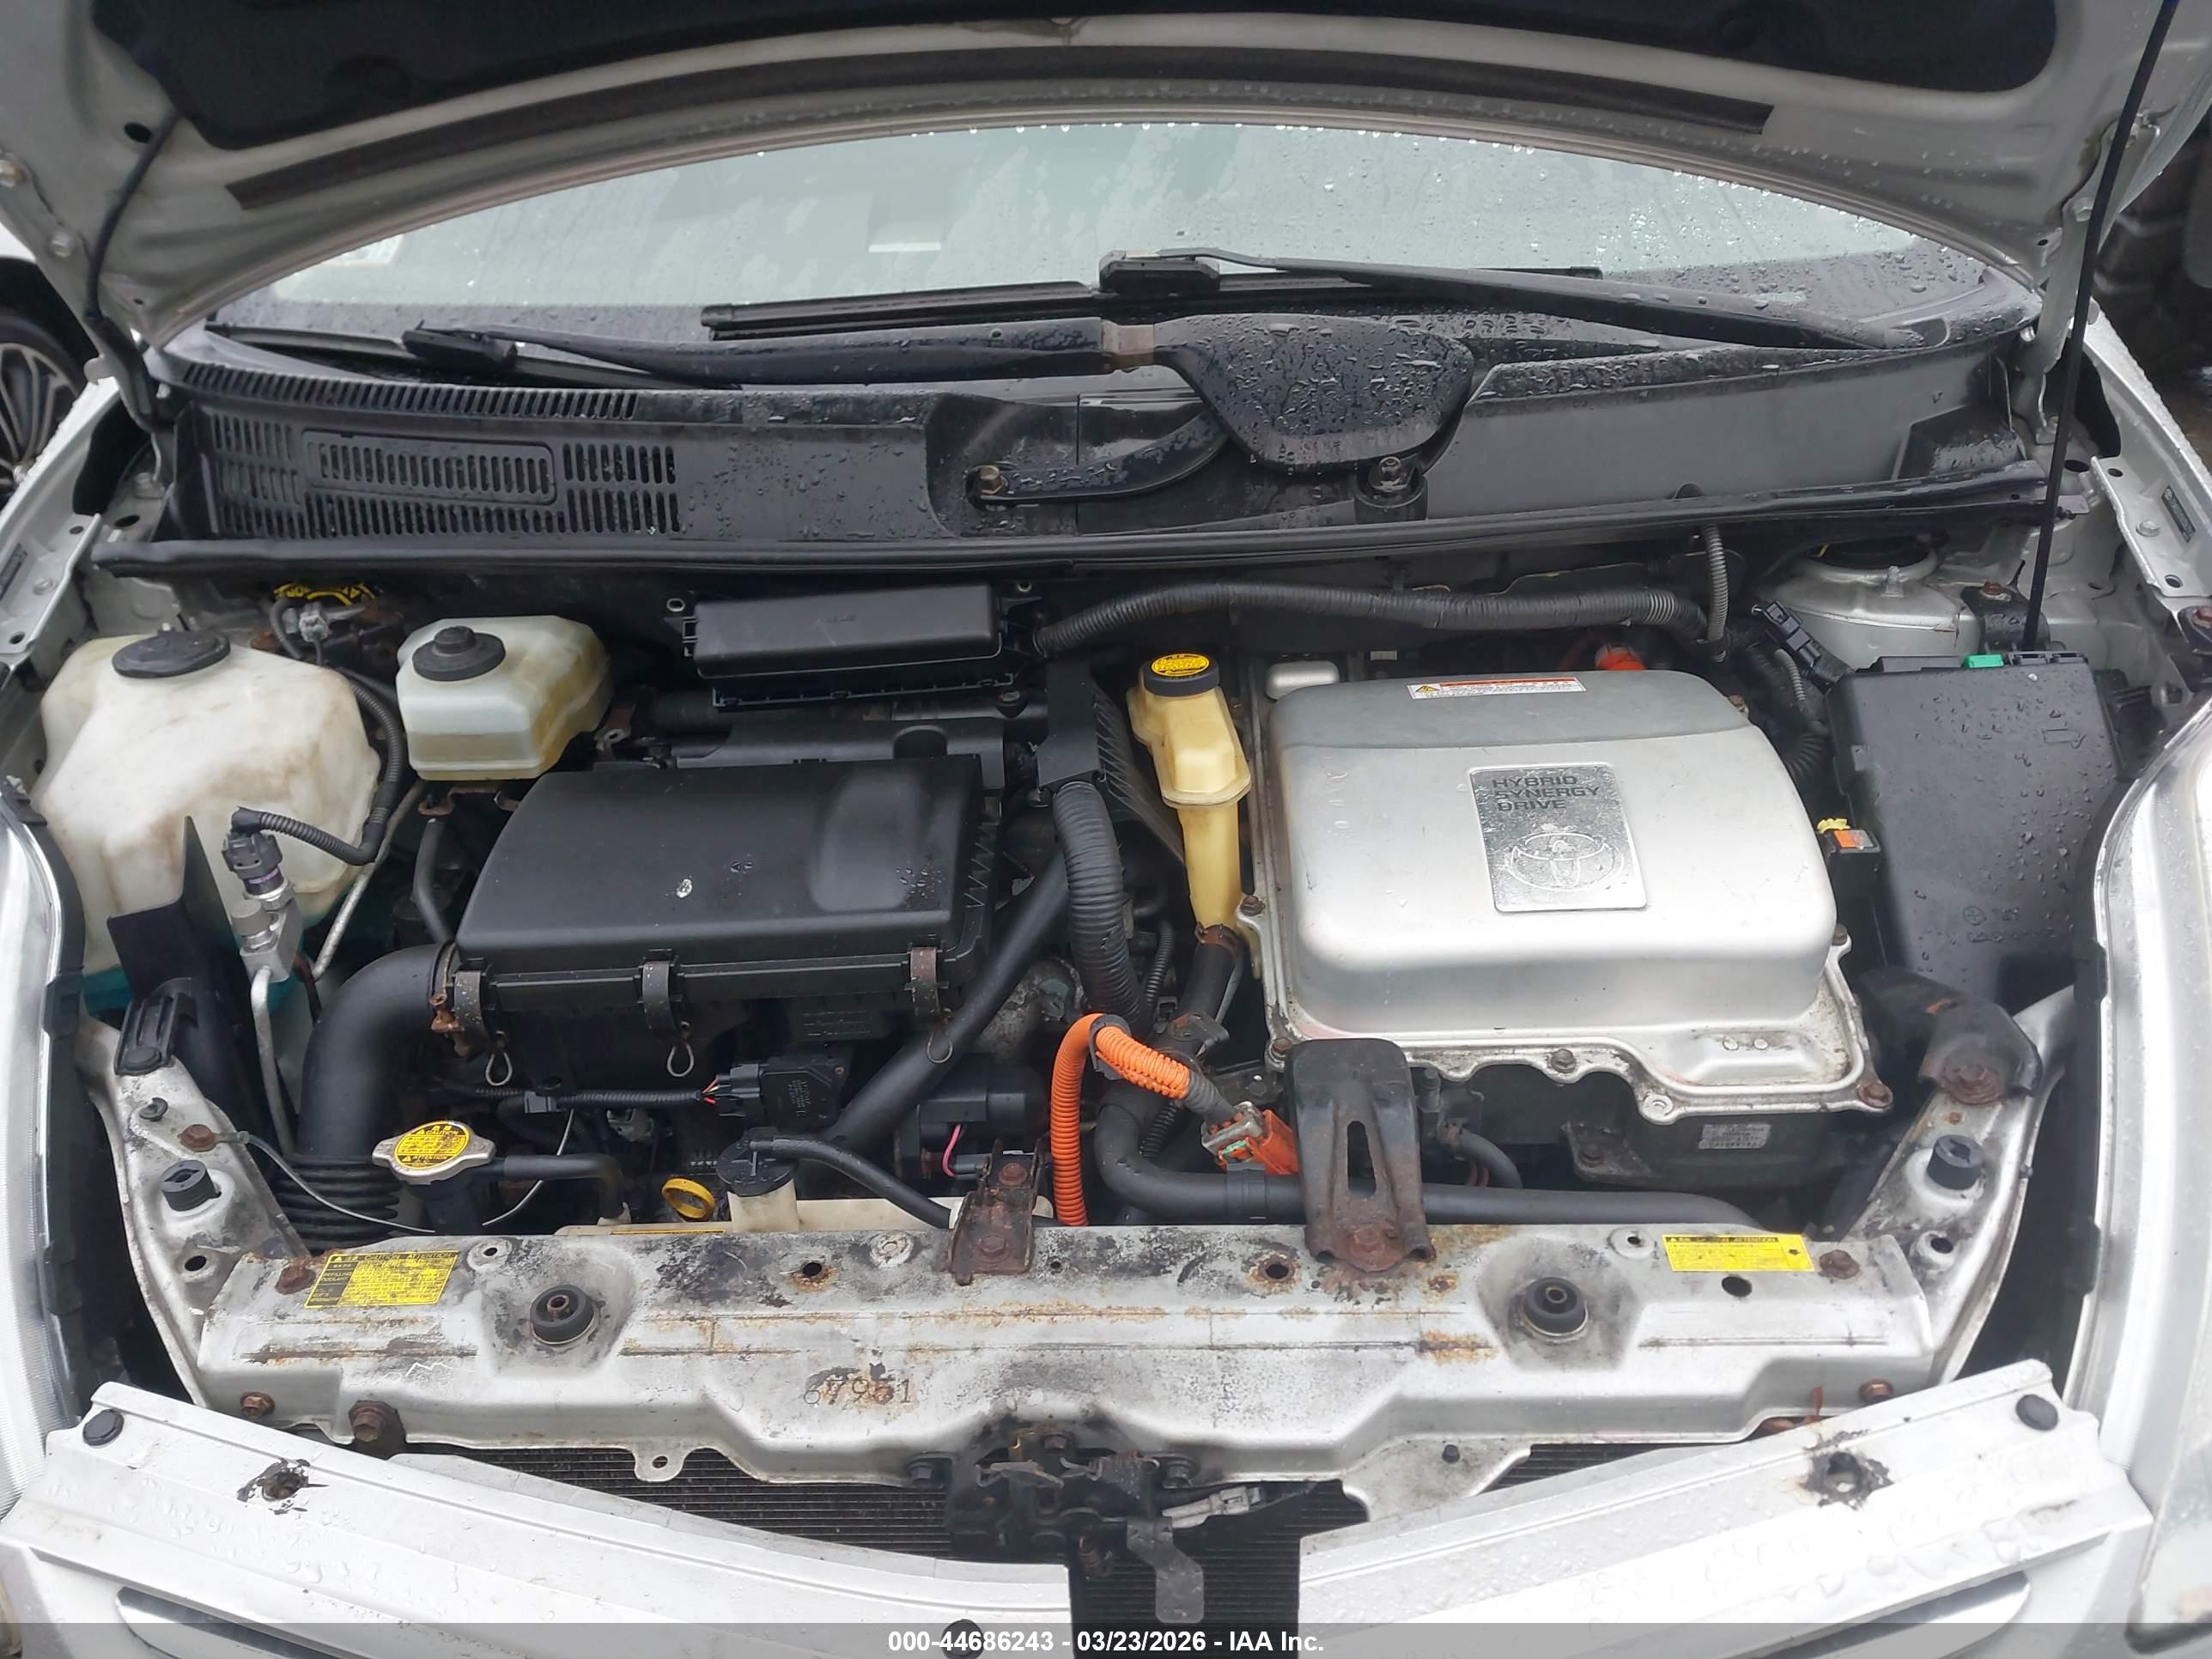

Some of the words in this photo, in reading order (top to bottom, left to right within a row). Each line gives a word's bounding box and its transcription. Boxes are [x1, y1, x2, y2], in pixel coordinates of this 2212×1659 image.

[1492, 775, 1578, 787] HYBRID
[1495, 787, 1601, 799] SYNERGY
[1497, 799, 1567, 811] DRIVE
